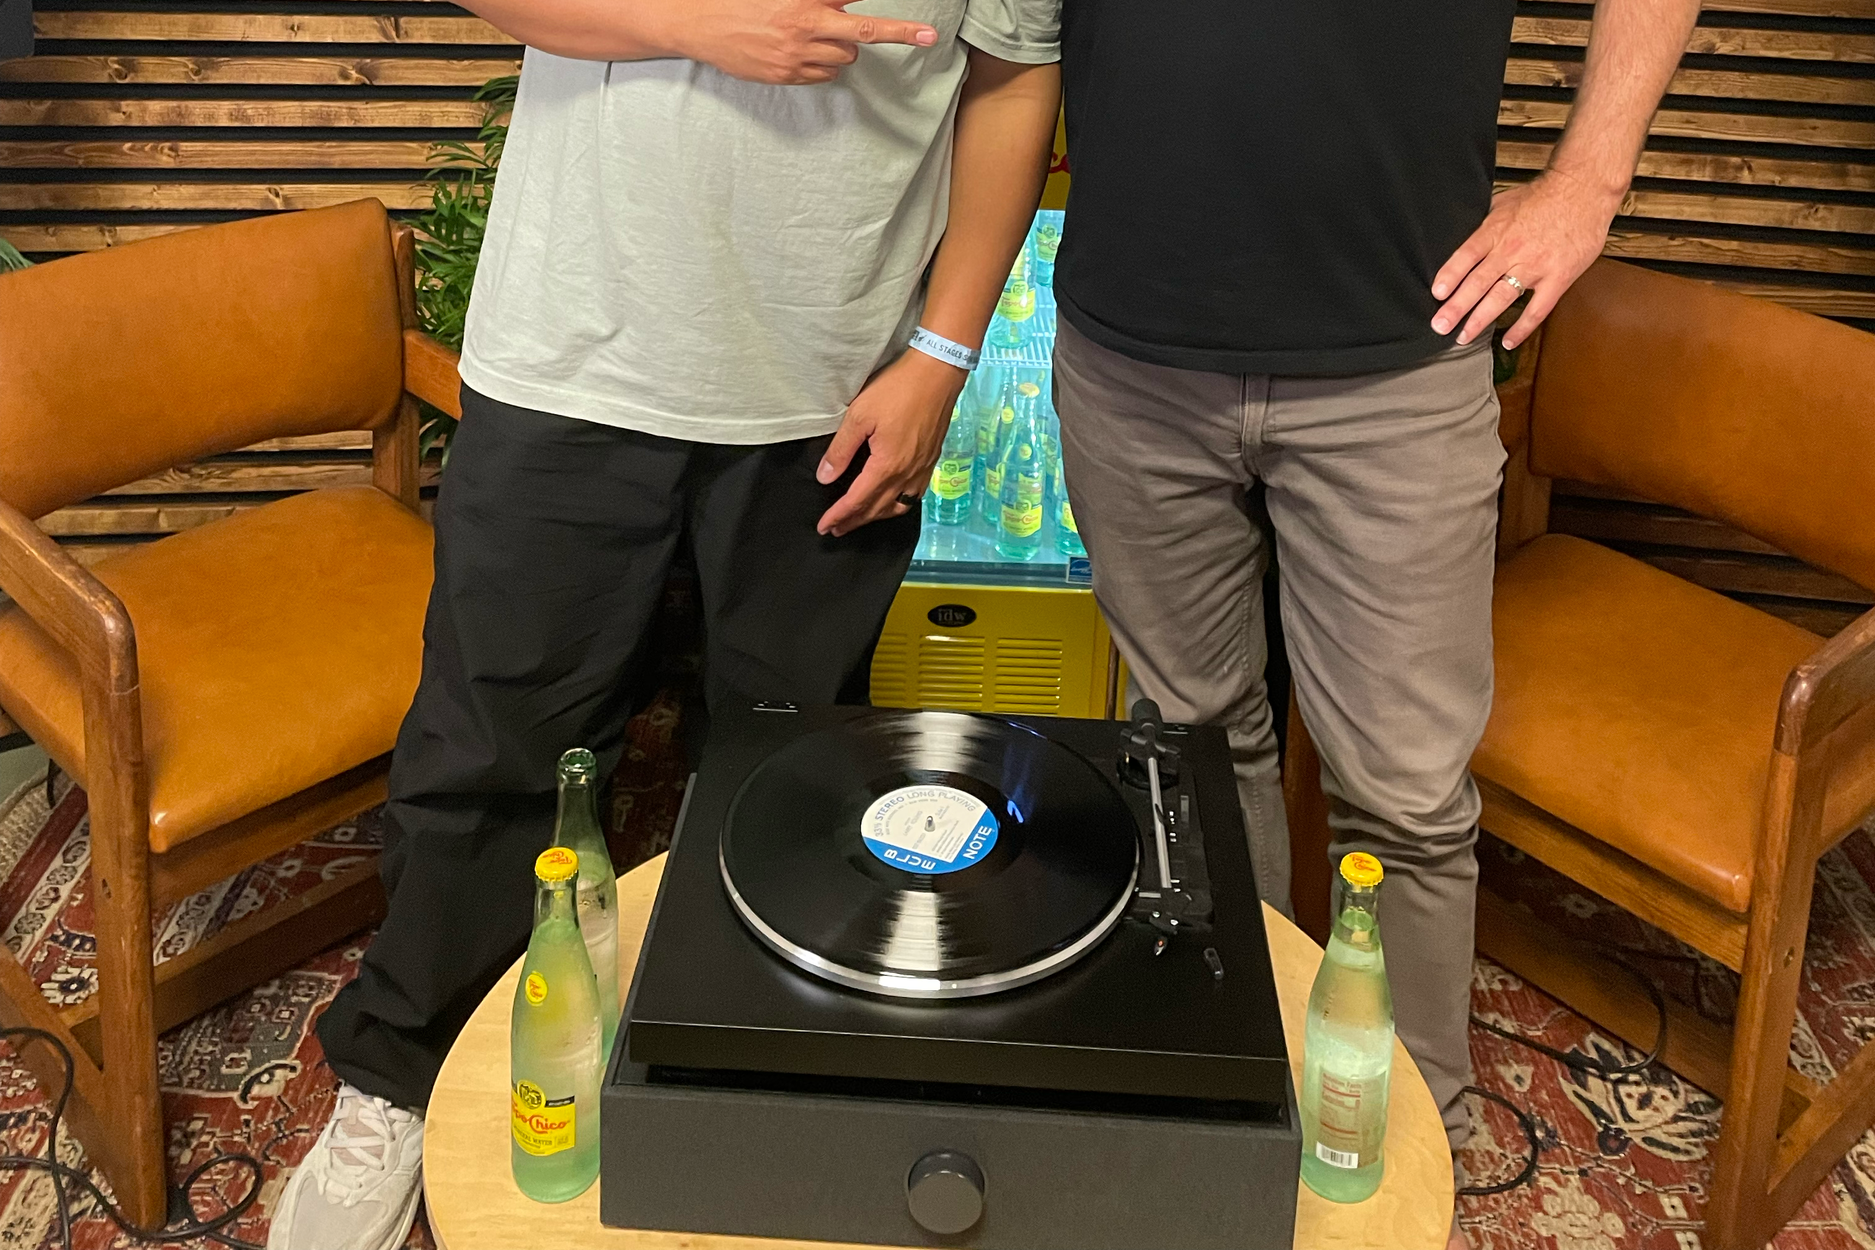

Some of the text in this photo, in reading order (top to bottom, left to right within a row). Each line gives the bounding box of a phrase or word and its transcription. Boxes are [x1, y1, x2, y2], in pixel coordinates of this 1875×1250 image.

[926, 339, 938, 349] ALL
[938, 344, 963, 359] STAGES
[874, 796, 905, 821] STEREO
[906, 791, 935, 800] LONG
[938, 791, 977, 812] PLAYING
[962, 825, 993, 859] NOTE
[883, 848, 936, 871] BLUE
[529, 1114, 568, 1135] Chico
